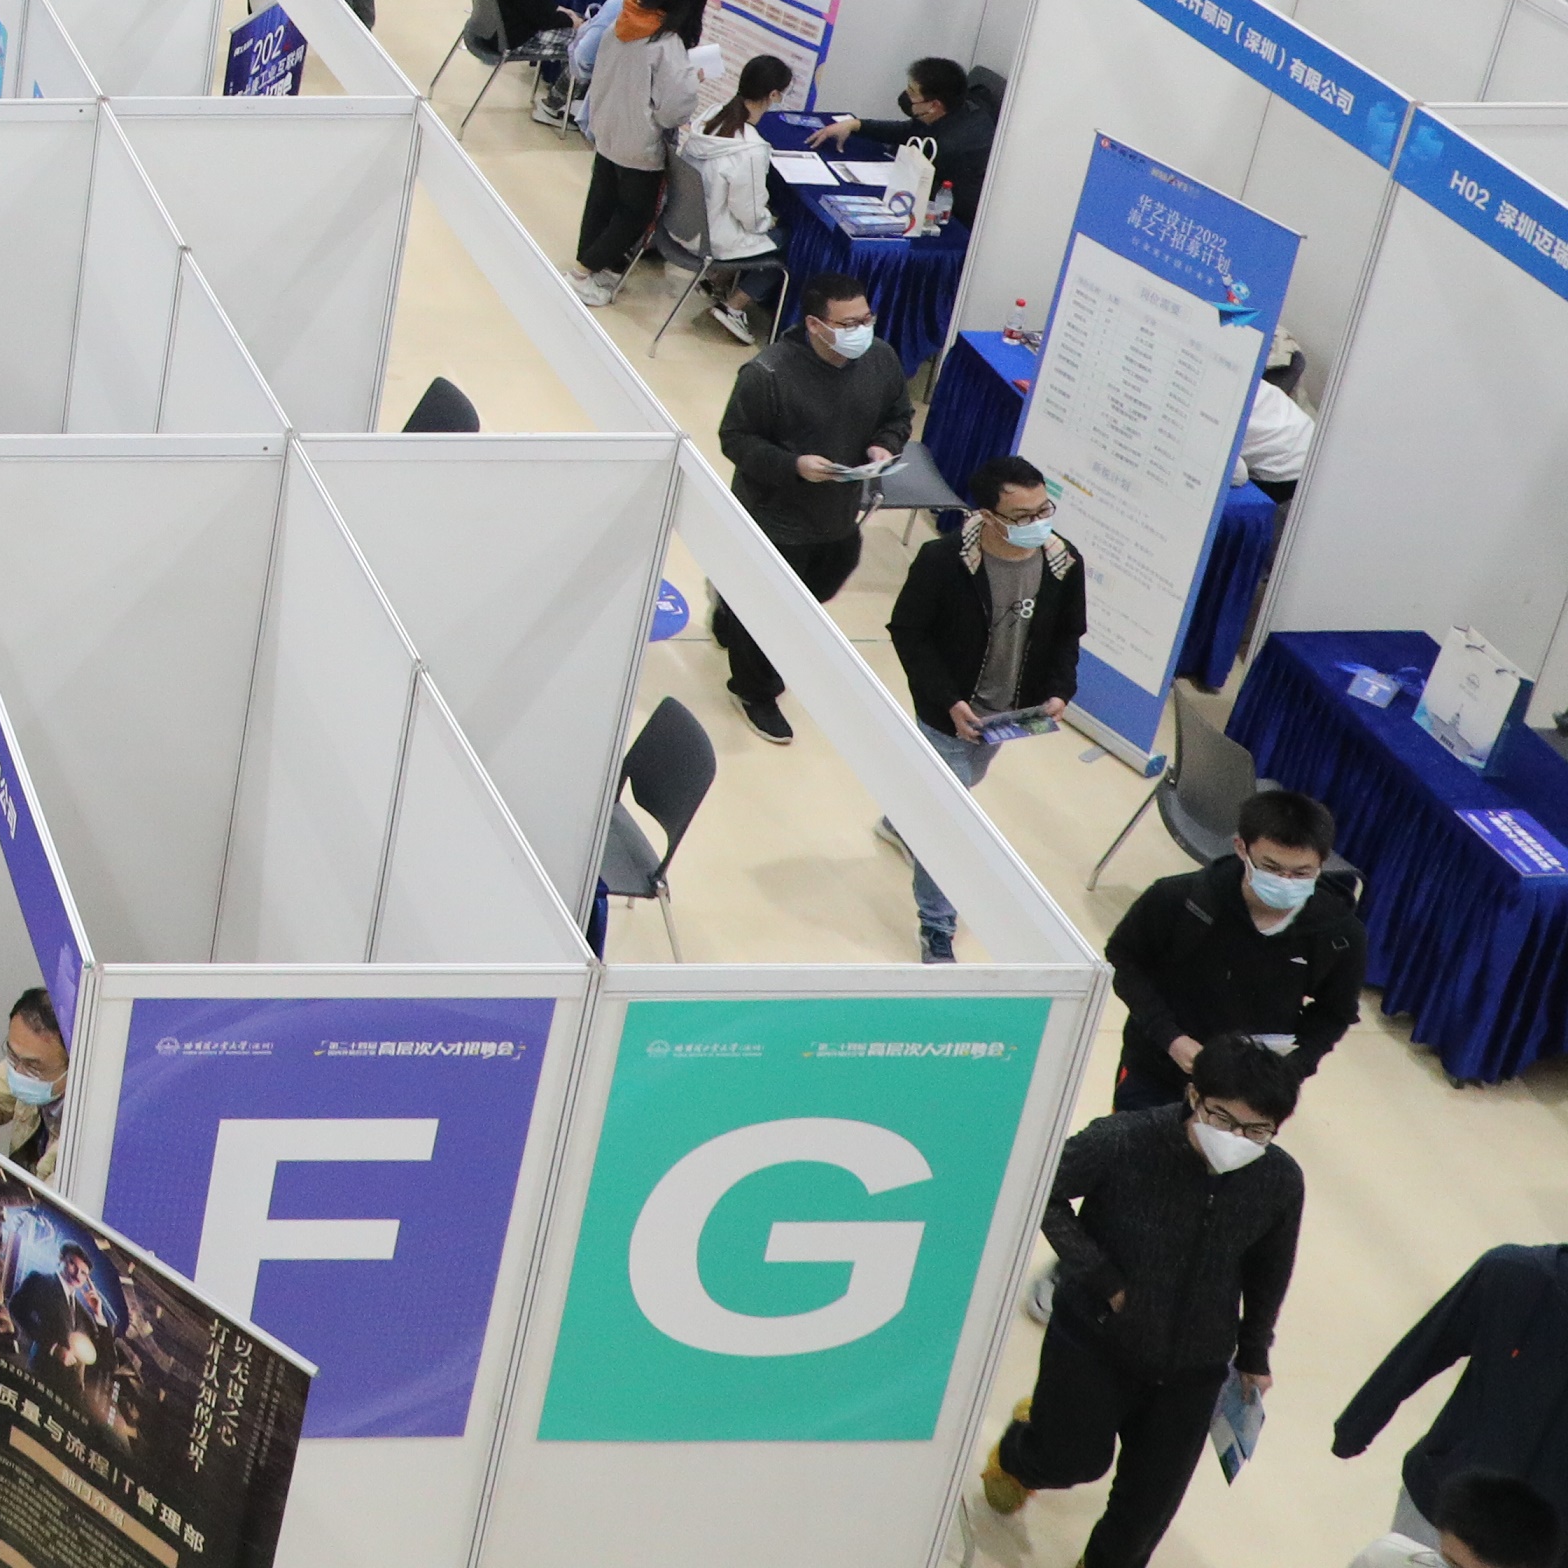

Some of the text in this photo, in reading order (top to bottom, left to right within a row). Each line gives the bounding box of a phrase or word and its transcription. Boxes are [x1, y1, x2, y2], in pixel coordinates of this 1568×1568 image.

[1449, 169, 1491, 212] H02
[1136, 192, 1228, 254] 华艺设计2022
[377, 1041, 515, 1059] 高层次人才招聘会
[866, 1041, 1006, 1060] 高层次人才招聘会
[193, 1117, 440, 1321] F
[628, 1116, 934, 1358] G
